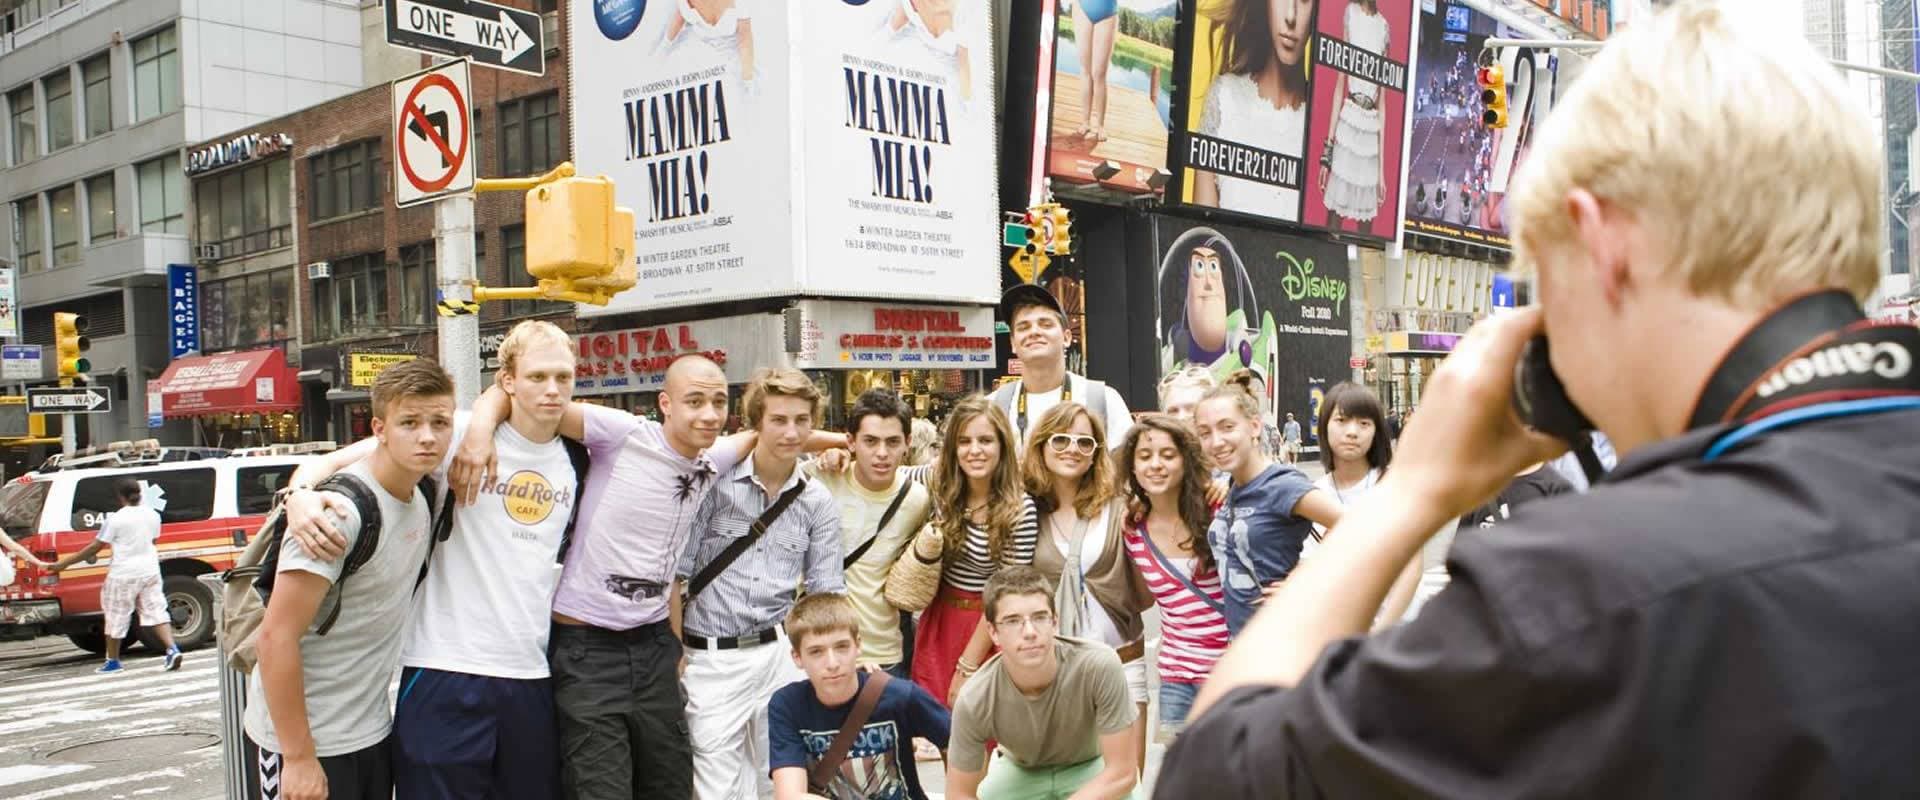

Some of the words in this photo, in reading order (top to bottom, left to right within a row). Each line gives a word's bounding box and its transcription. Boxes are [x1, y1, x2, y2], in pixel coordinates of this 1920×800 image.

[410, 6, 455, 38] ONE
[476, 20, 520, 51] WAY
[1318, 36, 1404, 89] FOREVER21.COM
[623, 80, 731, 161] MAMMA
[843, 67, 951, 145] MAMMA
[870, 137, 933, 204] MIA!
[1189, 137, 1297, 186] FOREVER21.COM
[647, 150, 709, 223] MIA!
[865, 226, 893, 237] WINTER
[895, 228, 921, 240] GARDEN
[923, 231, 952, 243] THEATRE
[865, 240, 907, 254] BROADWAY
[910, 244, 919, 255] AT
[940, 247, 964, 259] STREET
[643, 252, 669, 265] WINTER
[670, 248, 698, 261] GARDEN
[699, 243, 731, 256] THEATRE
[643, 266, 682, 280] BROADWAY
[685, 264, 694, 274] AT
[718, 256, 744, 269] STREET
[174, 288, 186, 349] BAGEL
[874, 307, 966, 333] DIGITAL
[1301, 305, 1315, 319] Fall
[579, 325, 698, 359] IGITAL
[602, 377, 628, 387] LUGGAGE
[1757, 342, 1913, 398] Canon
[40, 396, 65, 406] ONE
[74, 395, 98, 405] WAY
[531, 482, 571, 508] Rock
[516, 505, 540, 517] CAFE
